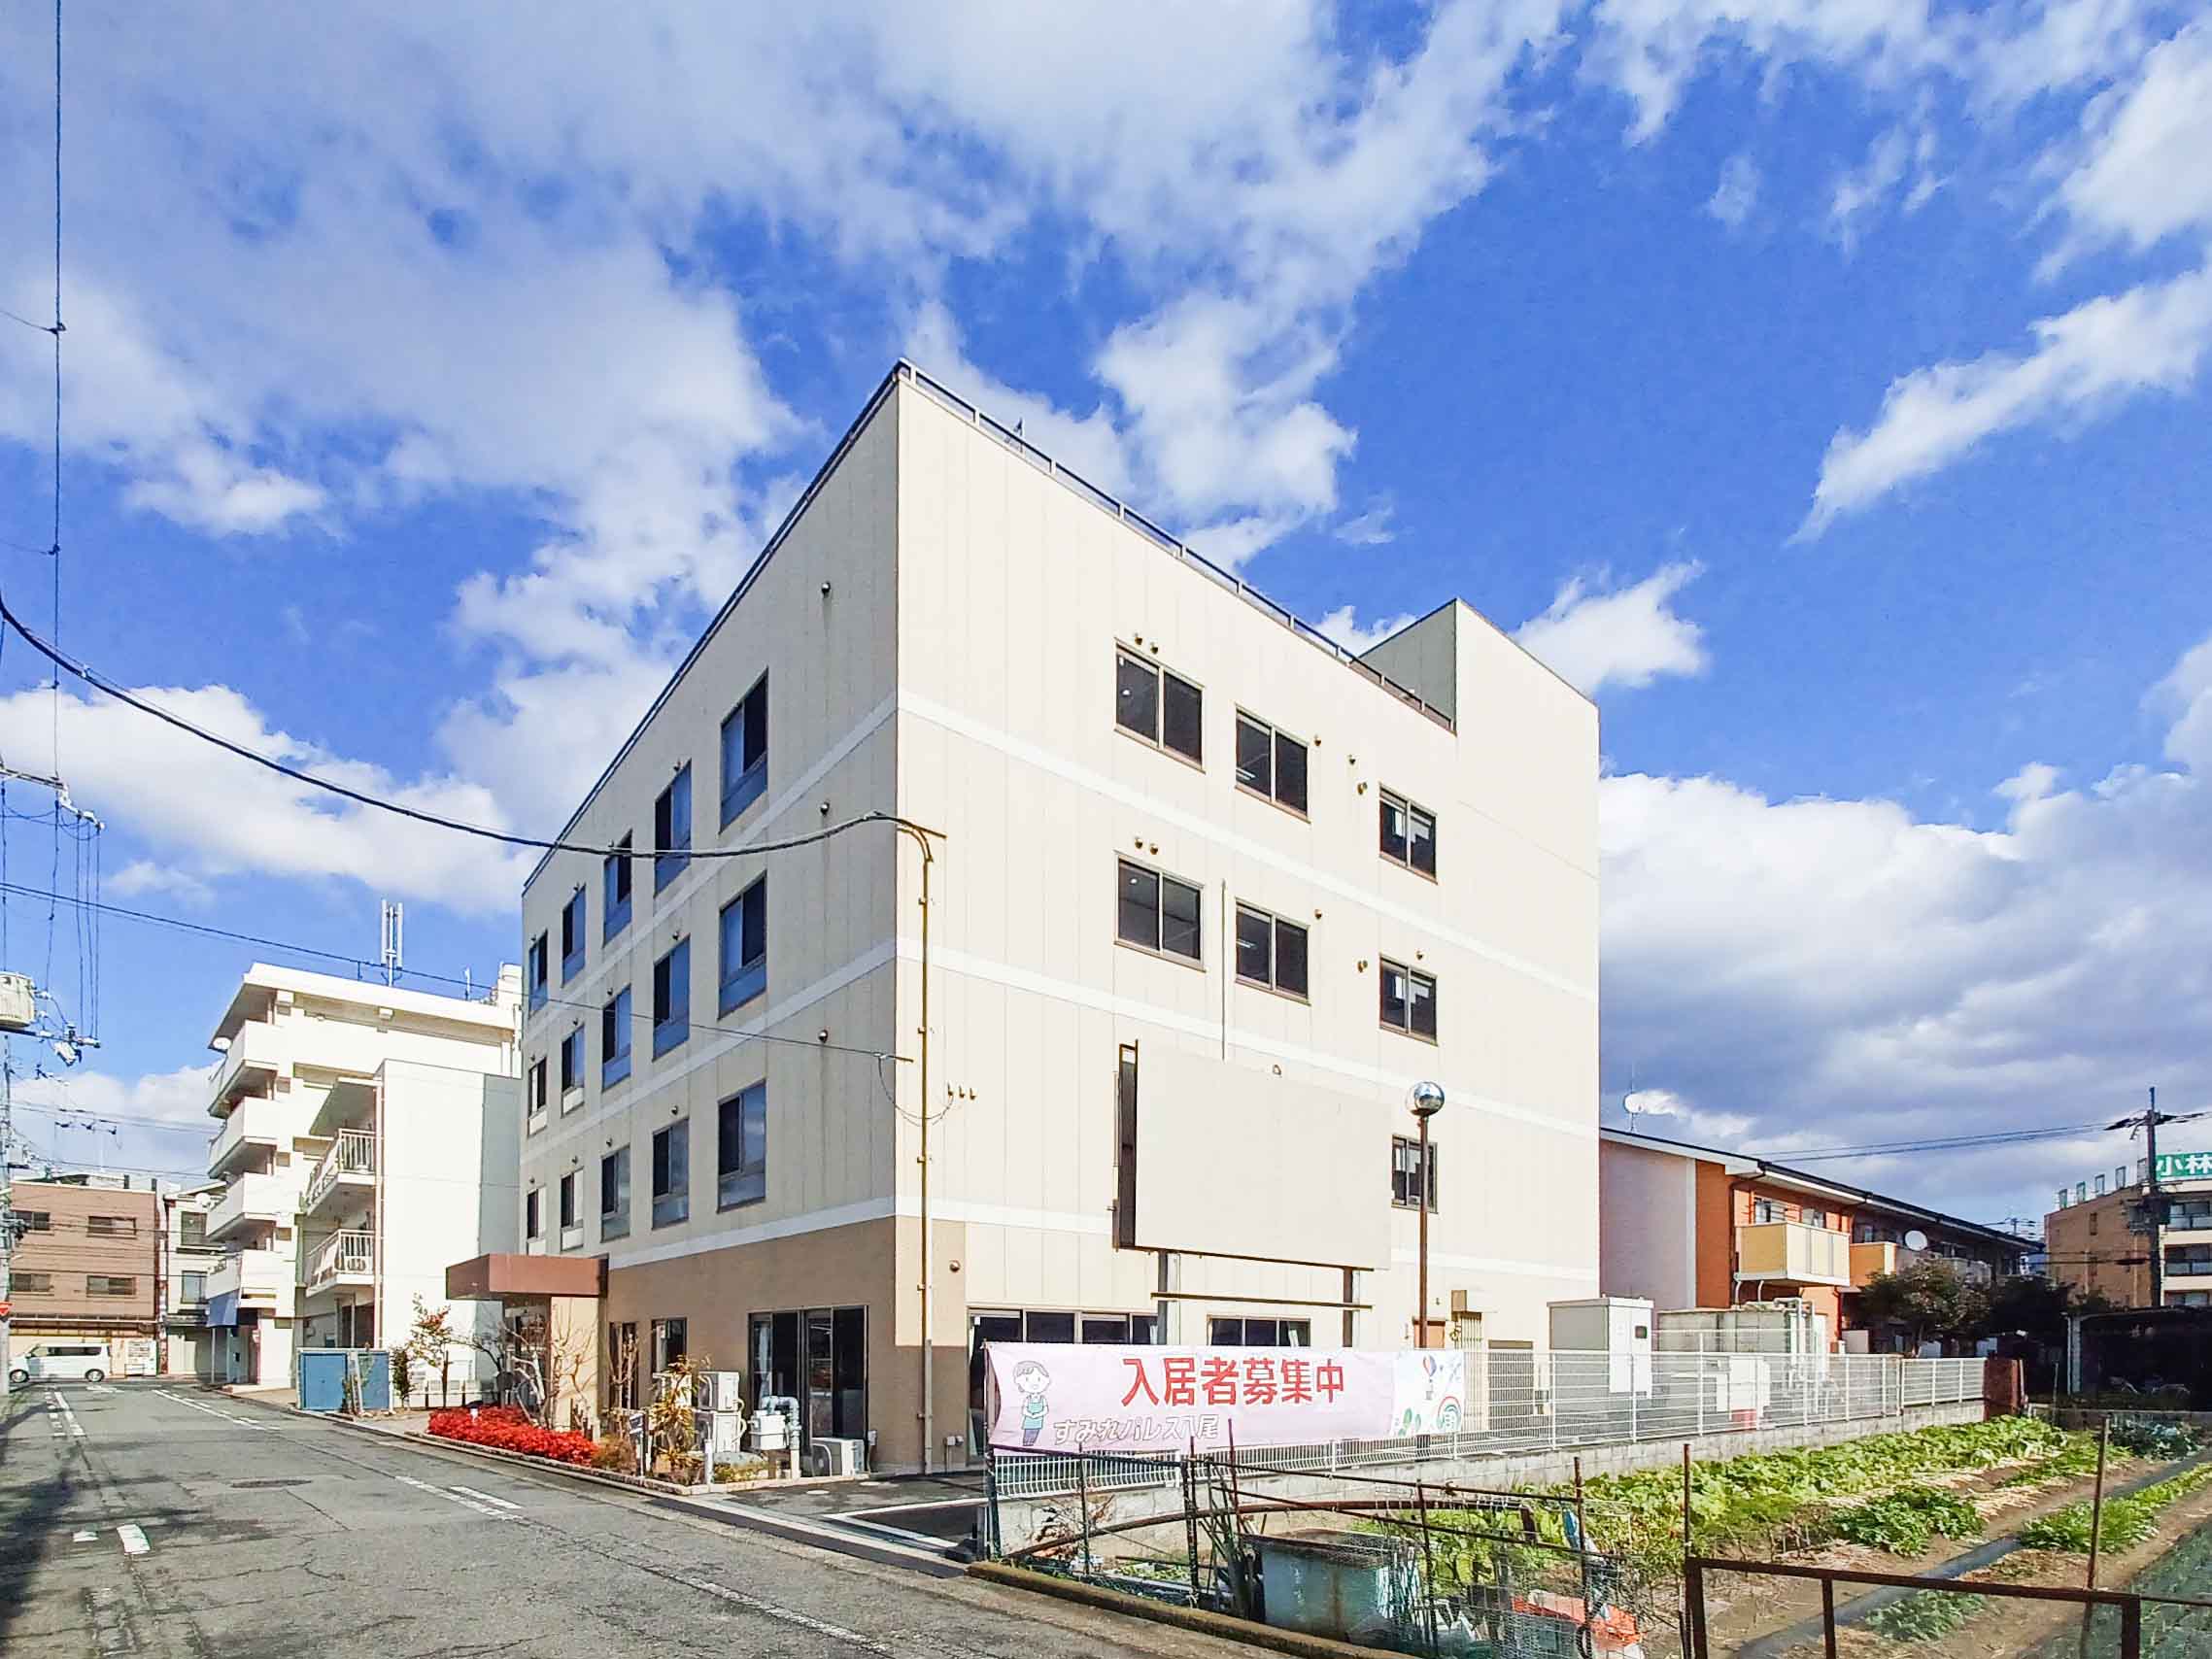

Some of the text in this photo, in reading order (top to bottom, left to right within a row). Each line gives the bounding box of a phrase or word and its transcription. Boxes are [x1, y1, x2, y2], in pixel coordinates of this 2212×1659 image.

[2156, 1154, 2212, 1175] 小林
[1121, 1357, 1344, 1406] 入居者募集中
